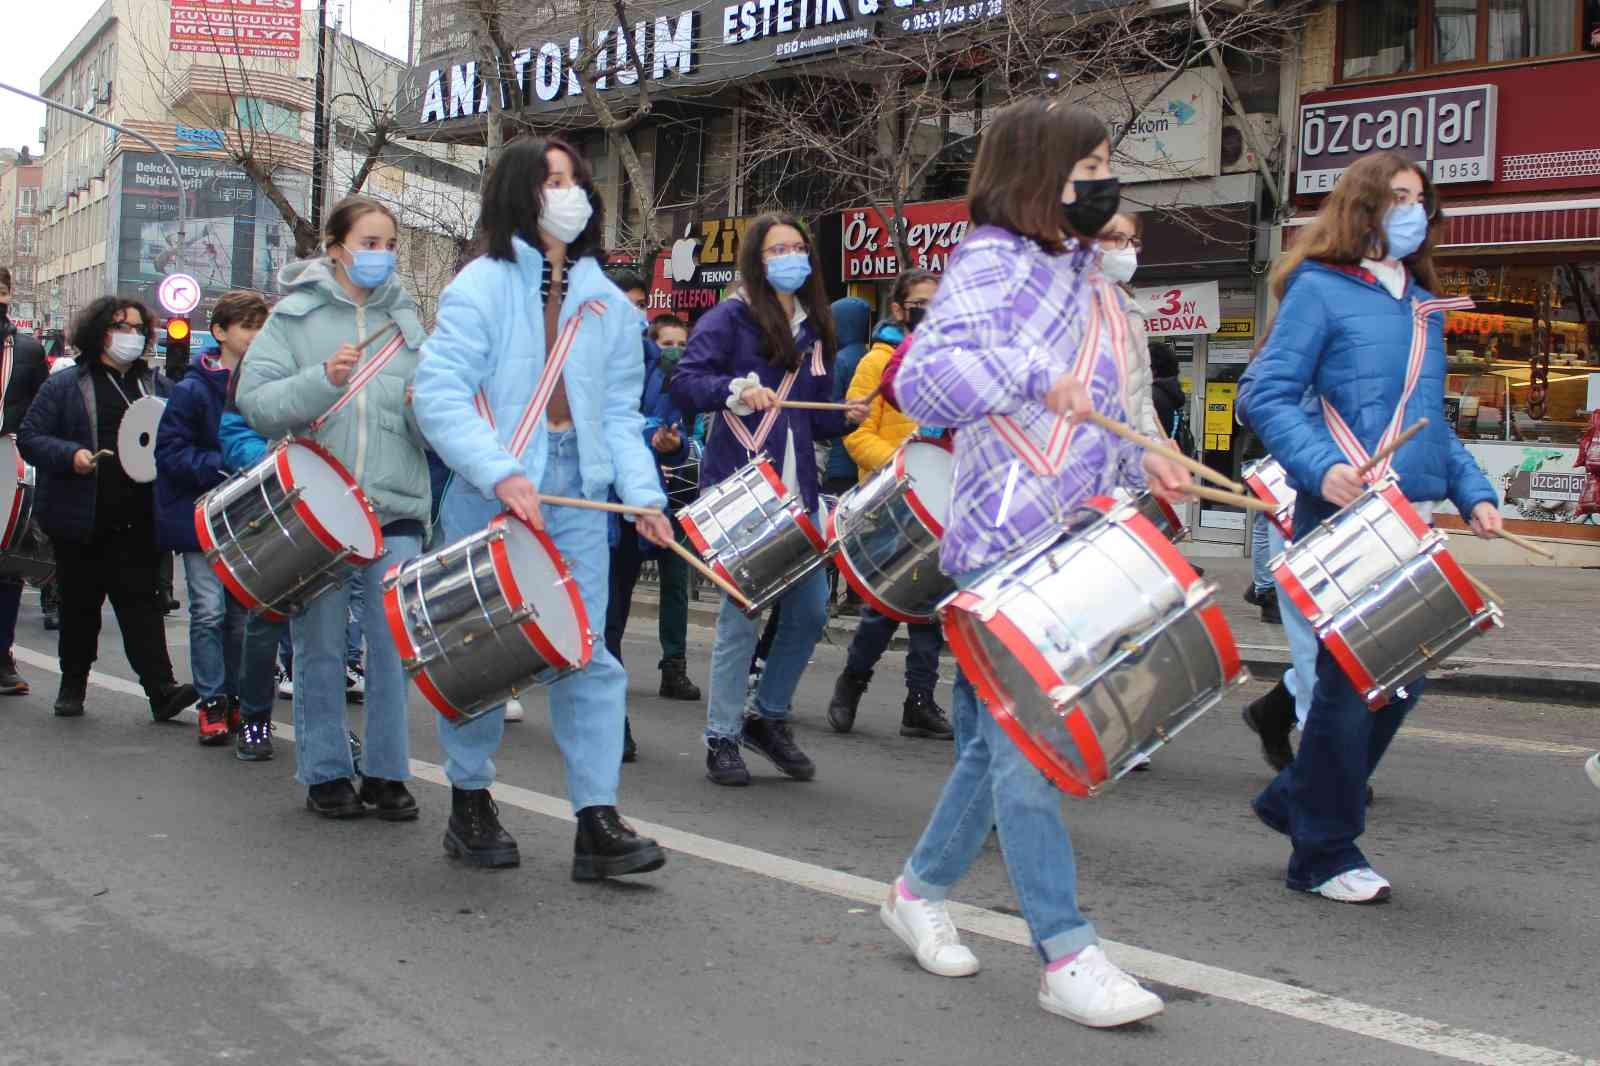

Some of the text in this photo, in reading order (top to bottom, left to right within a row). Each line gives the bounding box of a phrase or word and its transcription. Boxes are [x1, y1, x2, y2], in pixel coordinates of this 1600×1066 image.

[175, 24, 295, 41] MOBİLYA
[1439, 161, 1480, 179] 1953
[845, 211, 968, 254] Öz eyza
[850, 253, 902, 276] DÖNE
[701, 270, 732, 283] TEKNO
[672, 287, 717, 309] TELEFON
[1157, 288, 1182, 316] 3
[1183, 300, 1196, 315] AY
